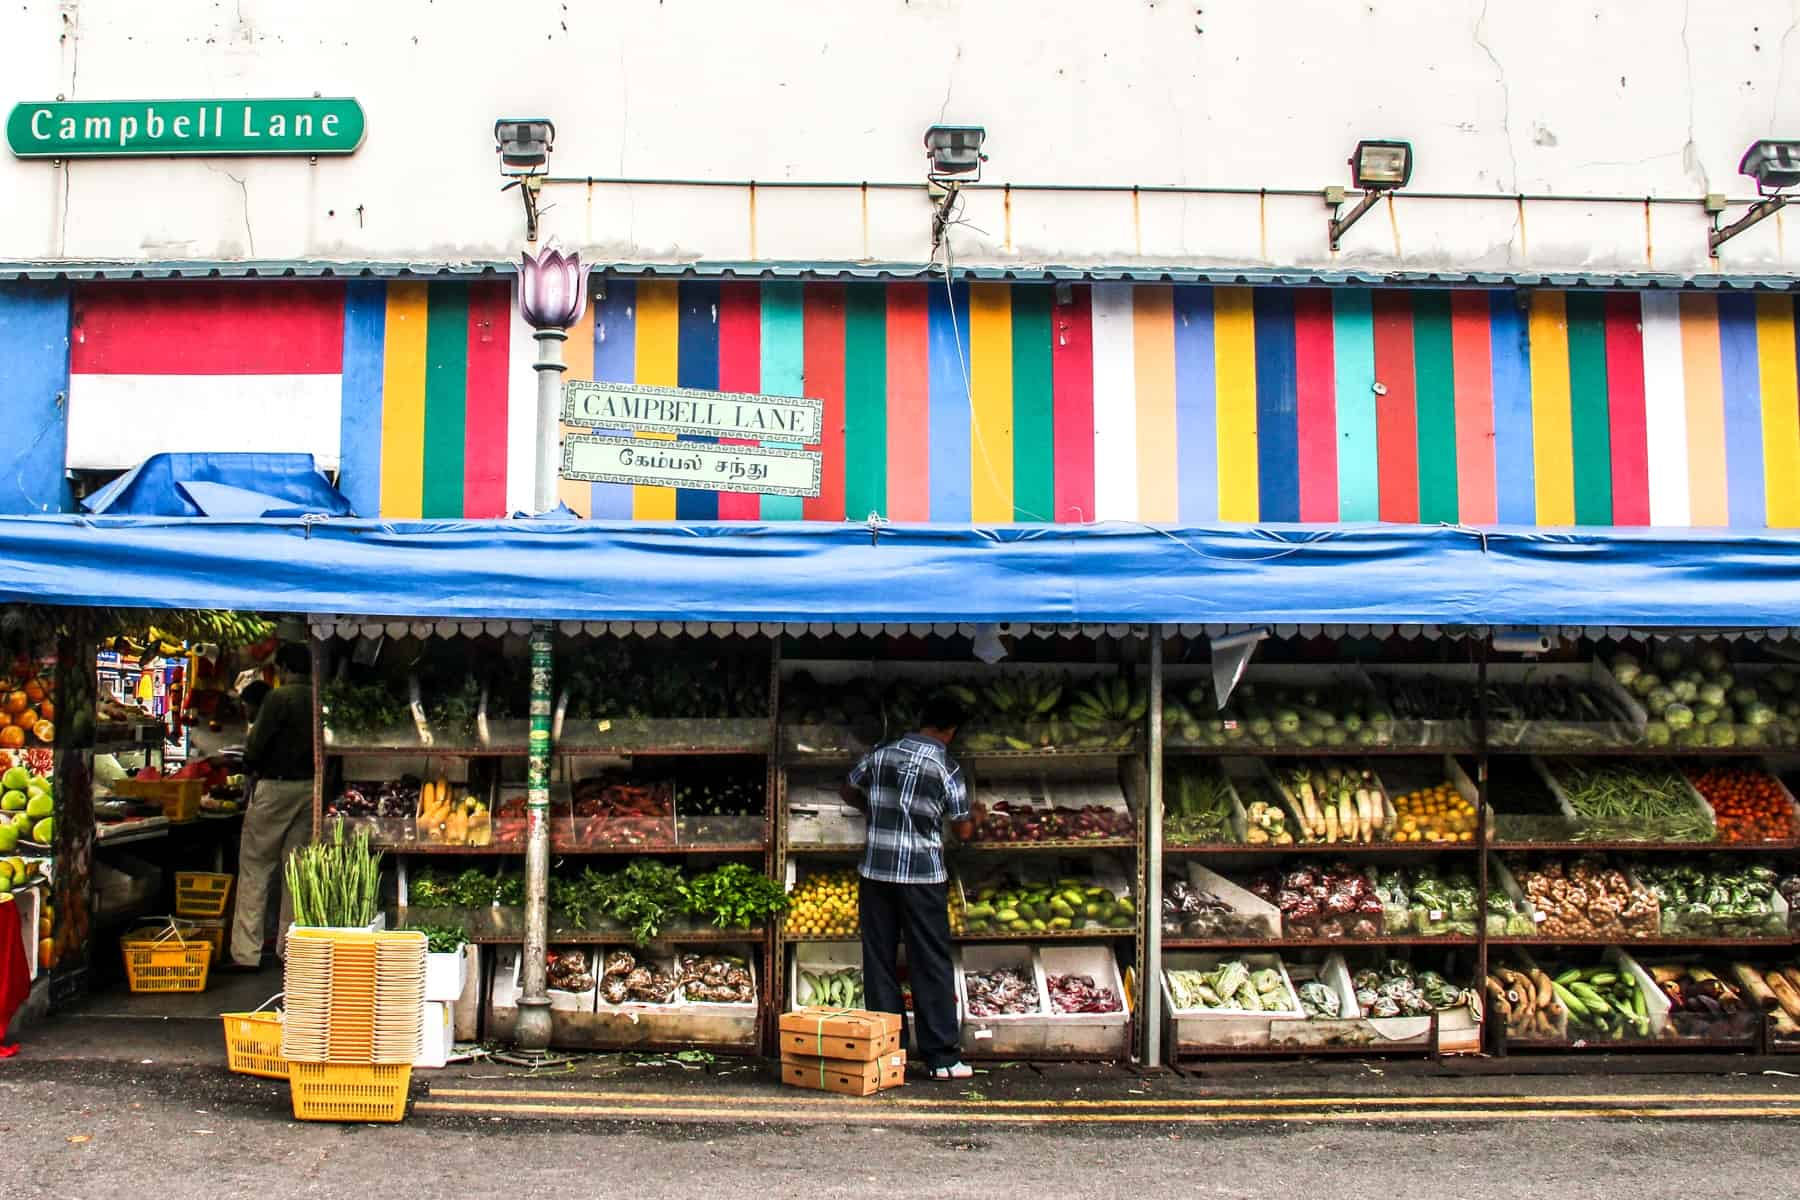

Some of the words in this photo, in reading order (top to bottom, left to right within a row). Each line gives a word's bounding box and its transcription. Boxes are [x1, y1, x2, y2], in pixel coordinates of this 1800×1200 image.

[31, 107, 223, 146] Campbell
[243, 106, 340, 138] Lane
[583, 394, 722, 425] CAMPBELL
[734, 405, 806, 432] LANE
[619, 447, 703, 471] கேம்பல்
[715, 456, 768, 480] சந்து
